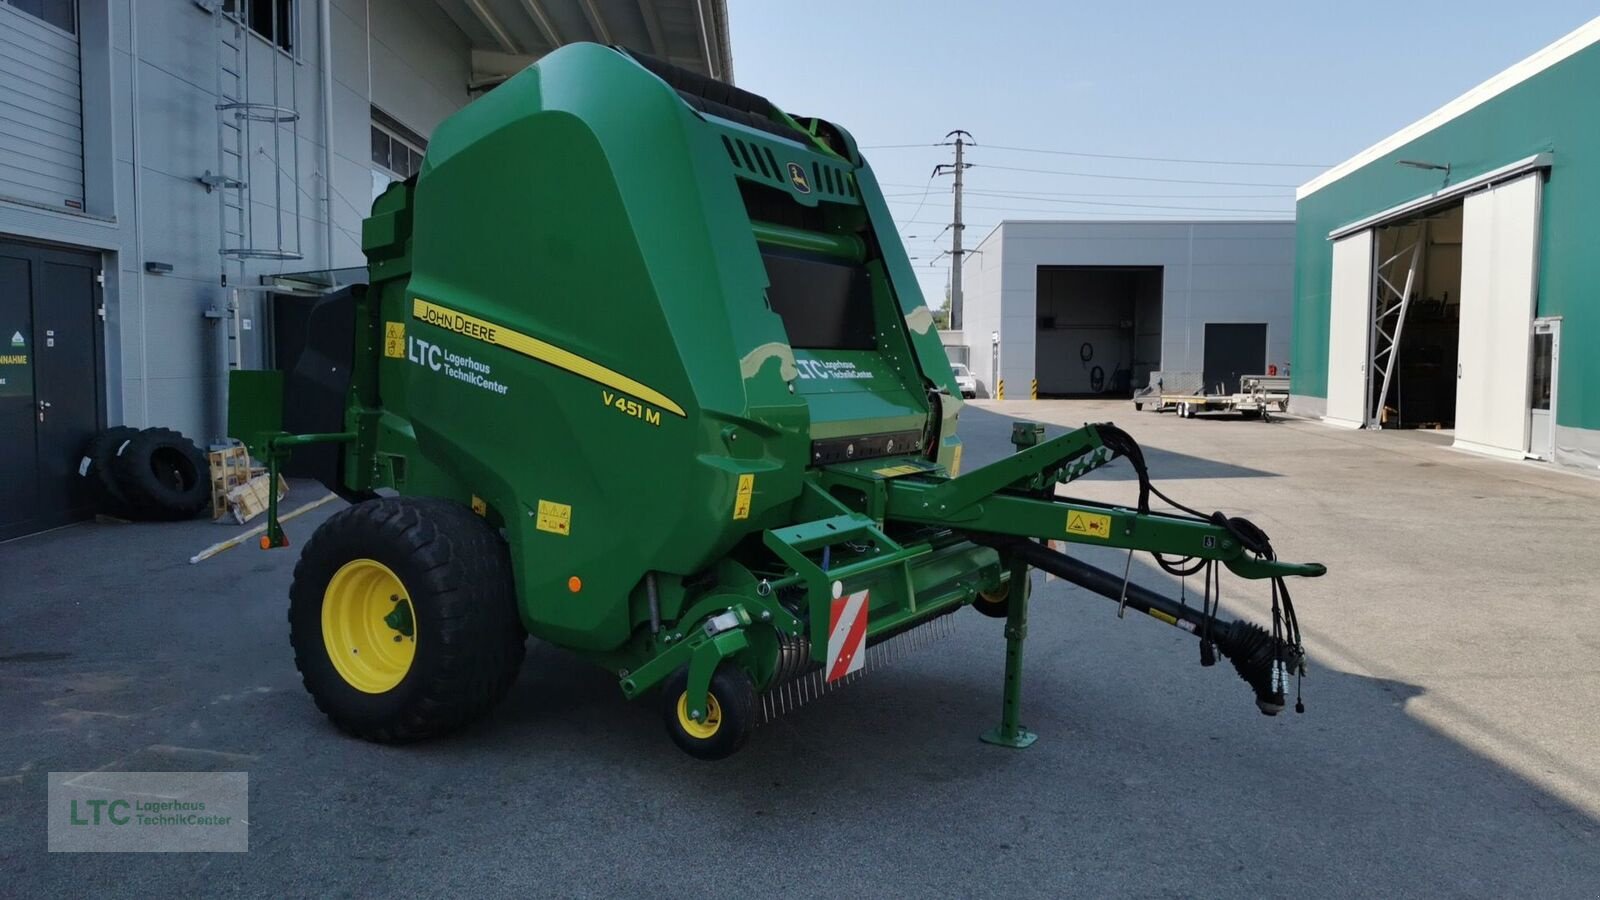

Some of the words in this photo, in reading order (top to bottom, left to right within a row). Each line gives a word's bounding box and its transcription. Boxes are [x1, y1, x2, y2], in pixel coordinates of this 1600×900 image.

[423, 305, 452, 328] JOHN
[455, 315, 497, 342] DEERE
[409, 336, 442, 371] LTC
[444, 349, 490, 374] Lagerhaus
[796, 359, 828, 379] LTC
[444, 363, 508, 394] TechnikCenter
[603, 390, 614, 406] V
[615, 397, 642, 419] 451
[646, 407, 660, 426] M
